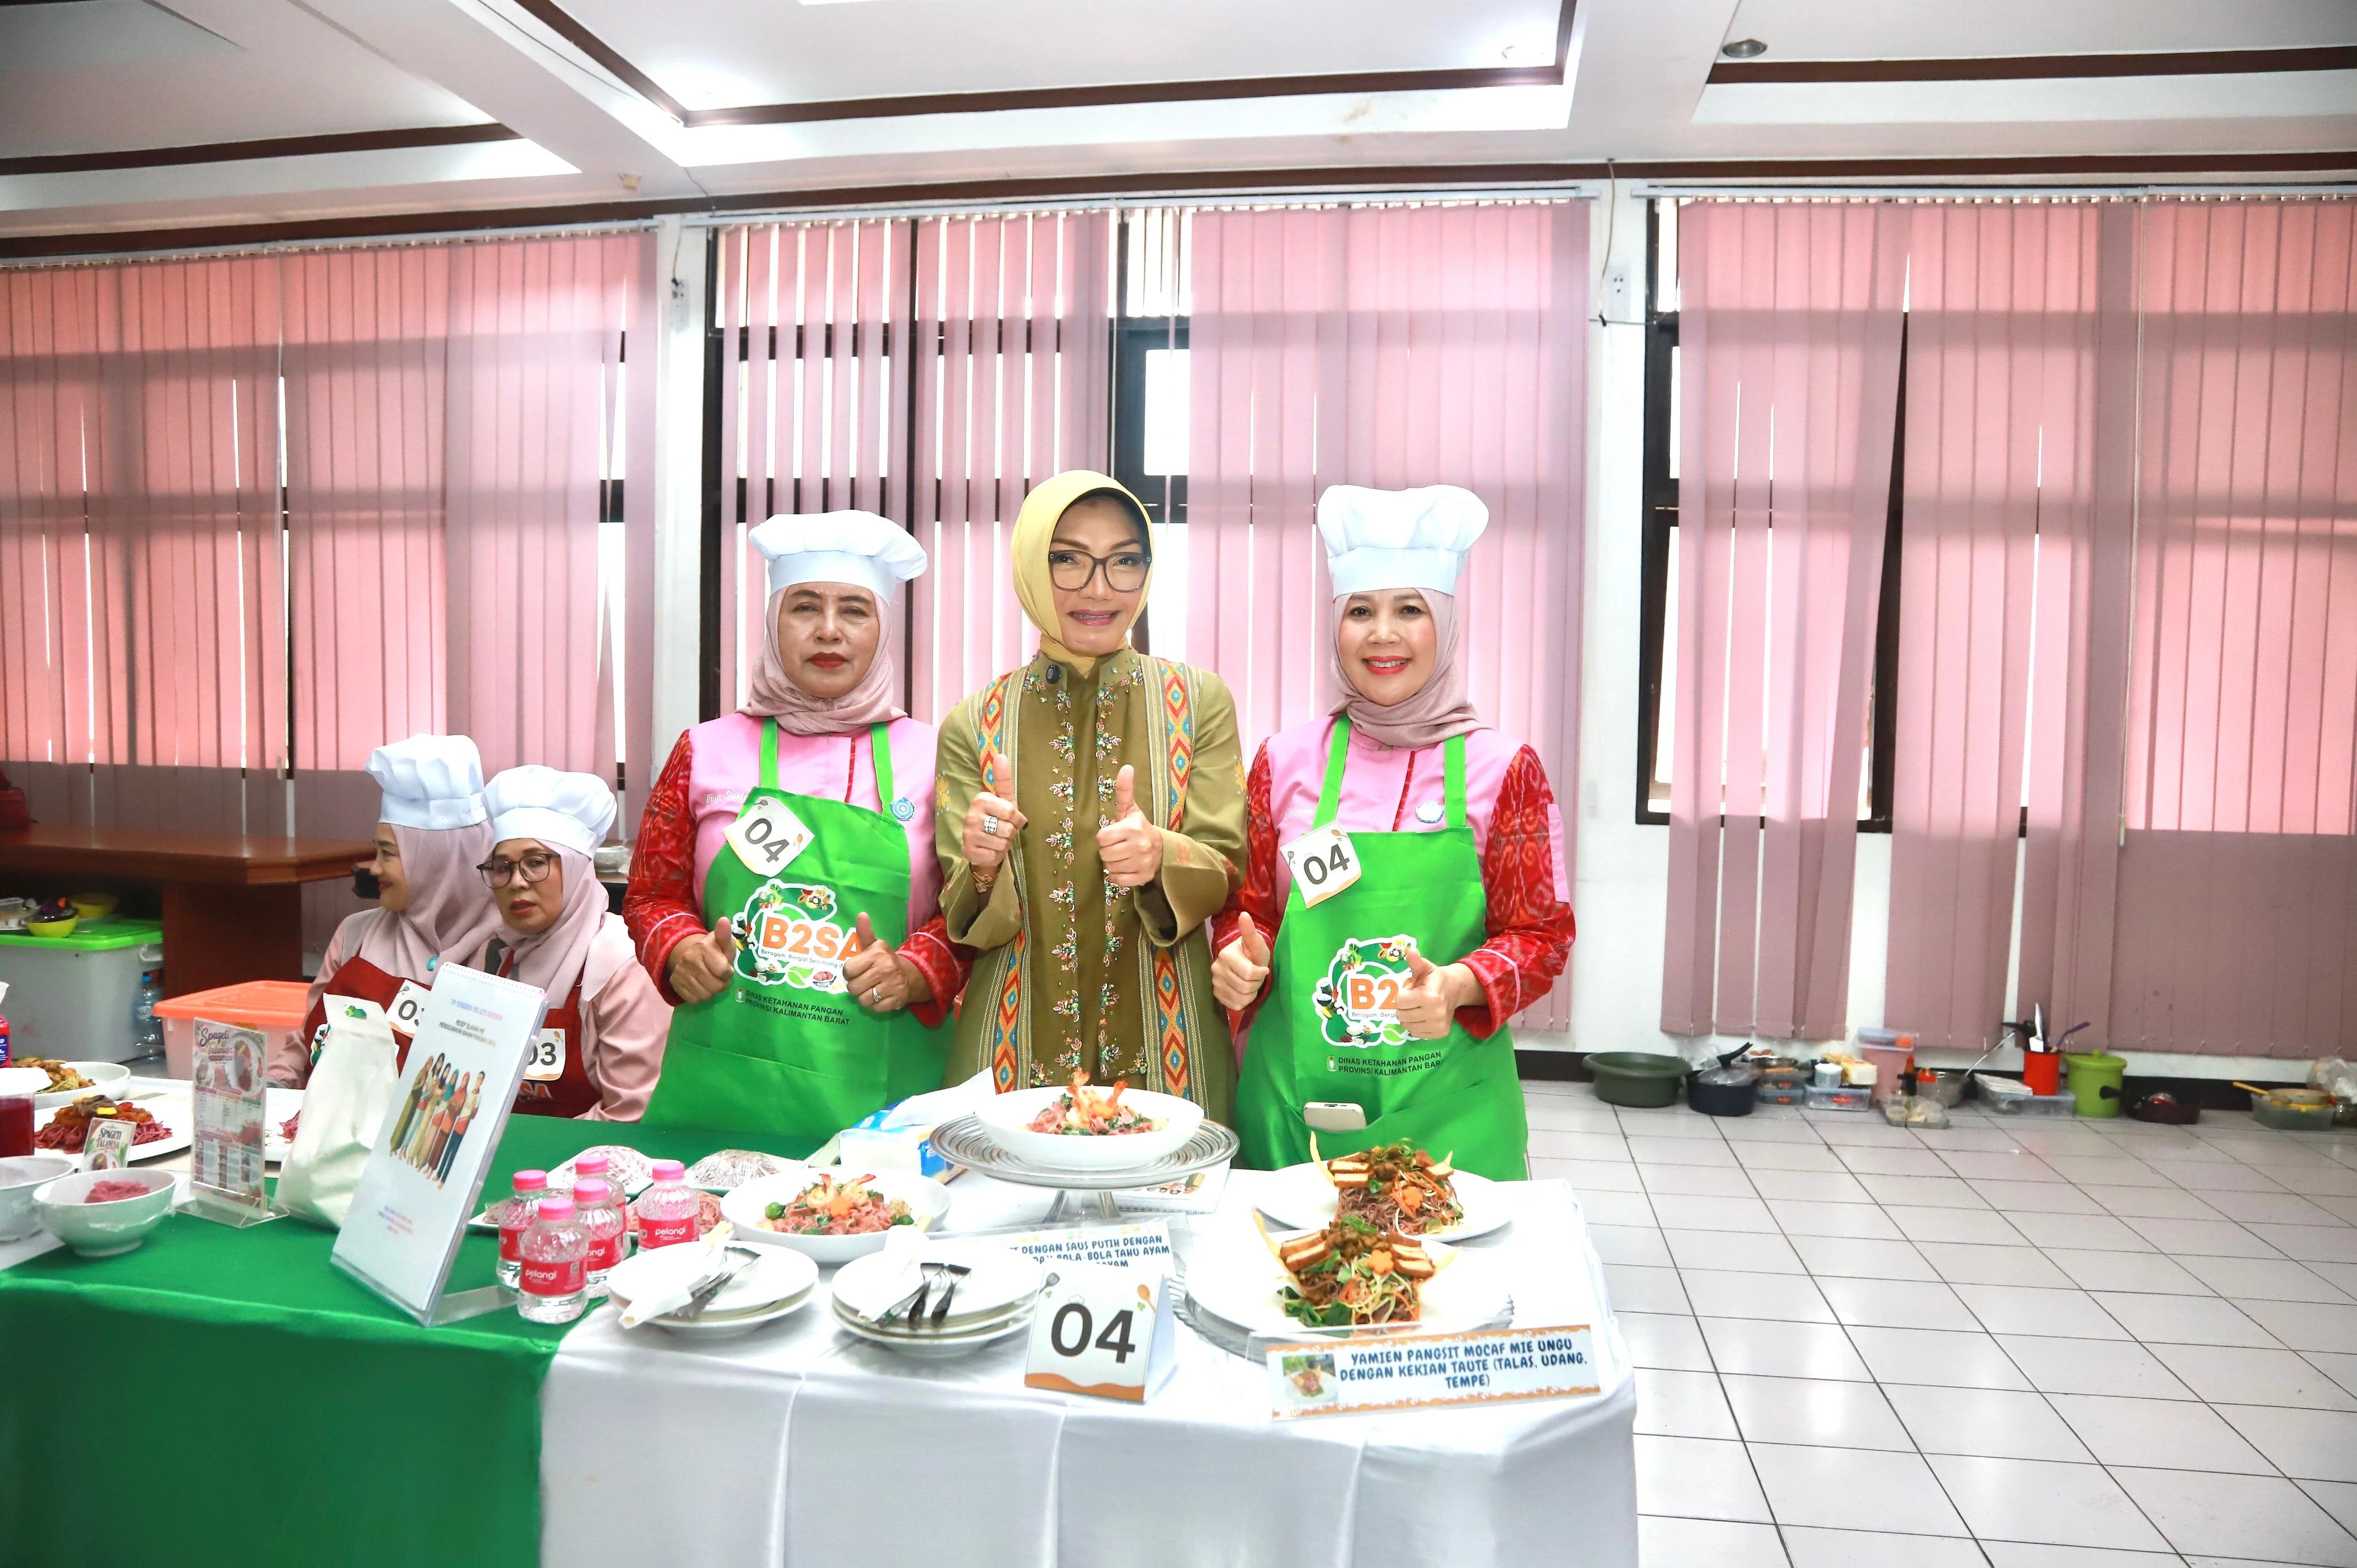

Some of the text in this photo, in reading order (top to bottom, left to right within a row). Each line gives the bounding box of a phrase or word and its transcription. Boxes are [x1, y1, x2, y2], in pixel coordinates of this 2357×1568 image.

[744, 818, 790, 863] 04
[1303, 843, 1350, 885] 04
[763, 917, 862, 961] B2SA
[761, 948, 787, 959] Beragam,
[746, 991, 843, 1016] DINAS KETAHANAN PANGAN
[1350, 978, 1414, 1010] B2
[398, 999, 424, 1026] 0
[746, 998, 850, 1025] PROVINSI KALIMANTAN BARAT
[1362, 1058, 1407, 1067] KETAHANAN
[1409, 1051, 1441, 1063] PANGAN
[1375, 1064, 1422, 1076] KALIMANTAN
[1425, 1060, 1444, 1069] BAR
[655, 1226, 686, 1236] pelangi
[588, 1246, 605, 1257] angi
[1022, 1235, 1162, 1254] DENGAN SAUS PUTIH DENGAN
[1115, 1247, 1139, 1258] TAHU
[1143, 1246, 1169, 1255] AYAM
[525, 1269, 557, 1280] pelangi
[1051, 1303, 1135, 1364] 04
[1351, 1339, 1572, 1366] YAMIEN PANGSIT MOCAF MIE UNGU
[1340, 1366, 1393, 1381] DENGAN
[1398, 1362, 1446, 1377] KEKIAN
[1451, 1359, 1488, 1373] TAUTE
[1445, 1374, 1490, 1389] TEMPE)
